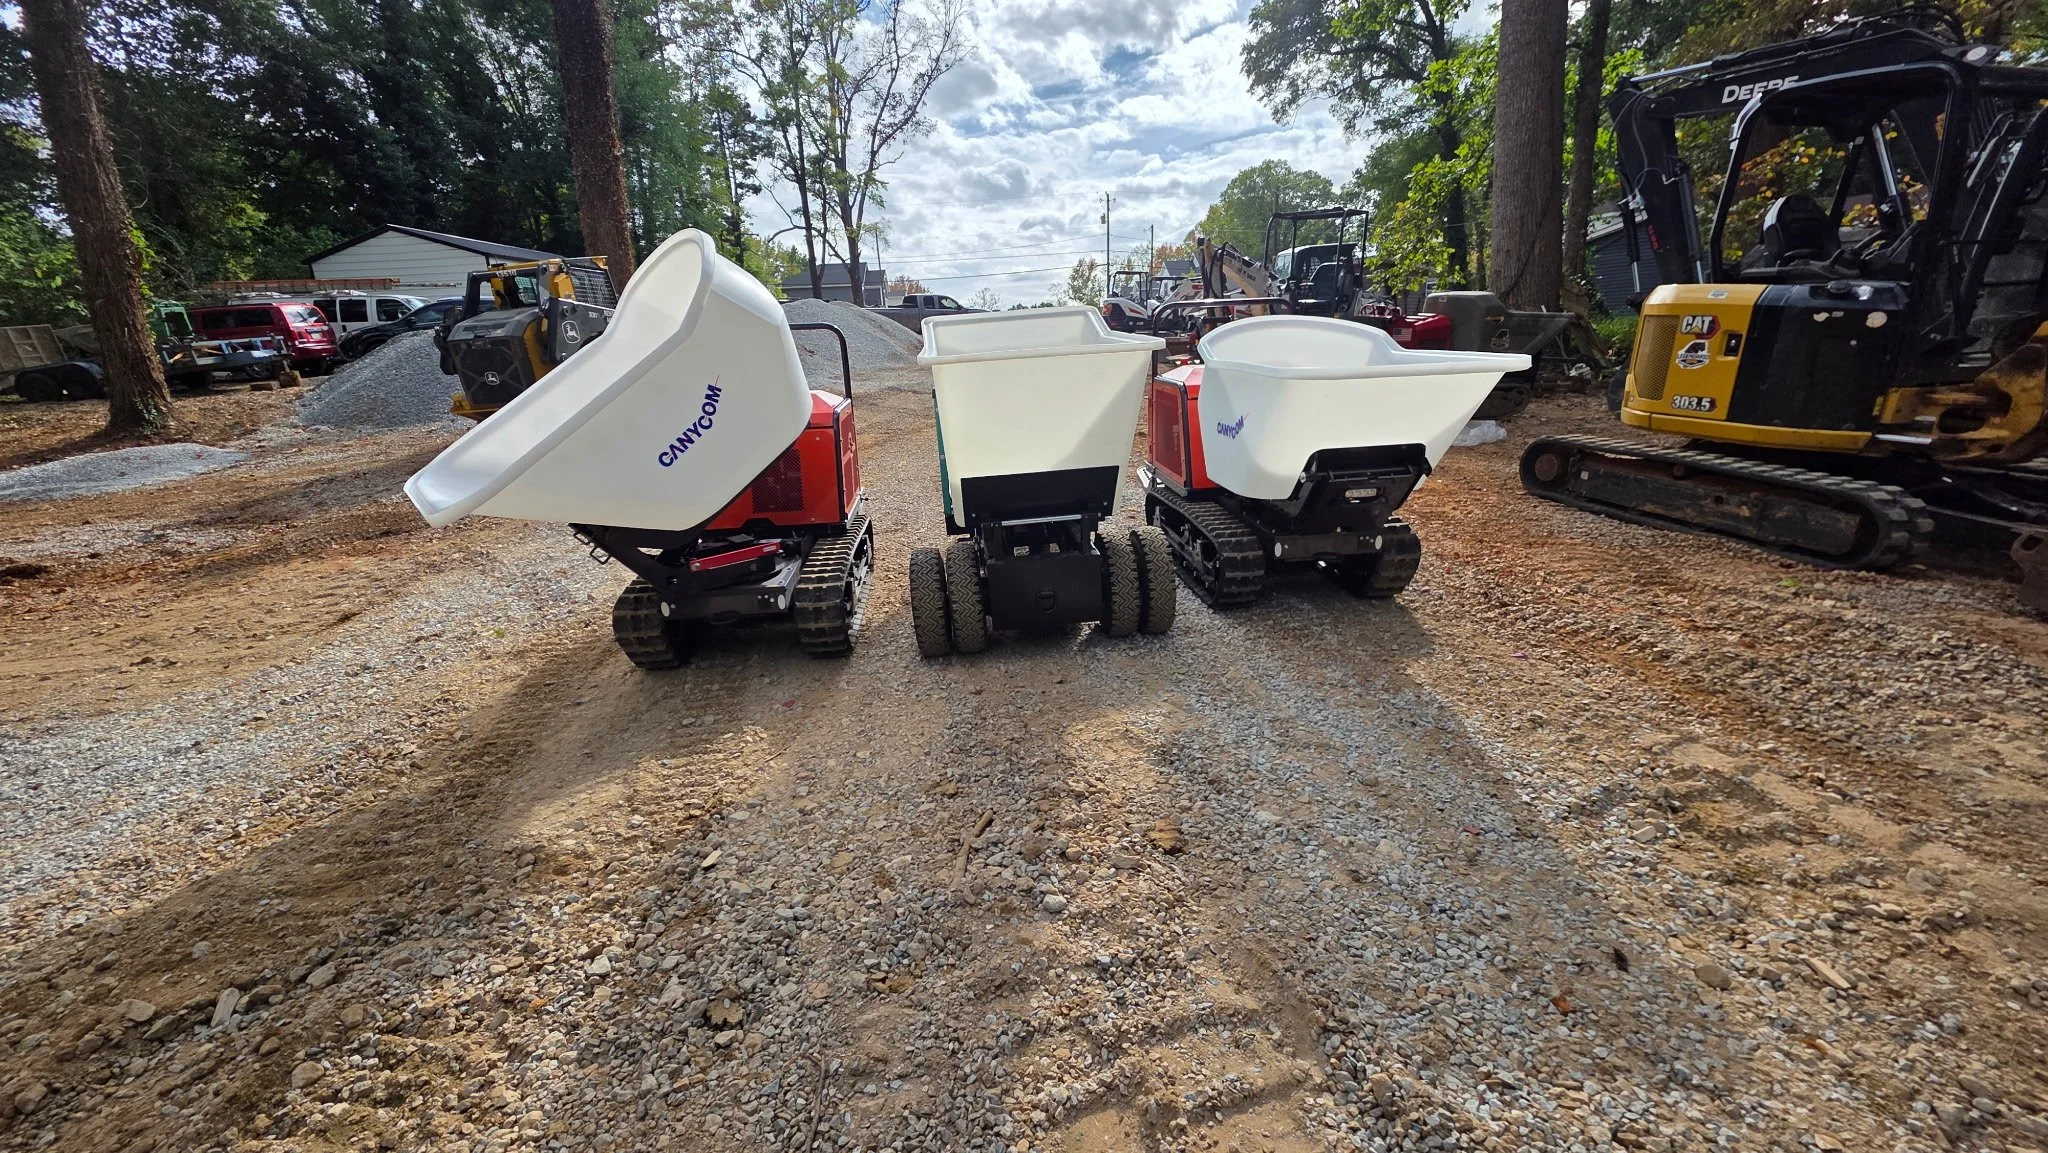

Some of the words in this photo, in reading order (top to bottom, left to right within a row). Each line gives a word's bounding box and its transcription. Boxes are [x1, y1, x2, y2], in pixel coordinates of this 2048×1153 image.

[1681, 315, 1713, 334] CAT
[1671, 395, 1711, 411] 303.5
[658, 384, 722, 467] CANYCOM
[1216, 415, 1244, 439] CANYCOM
